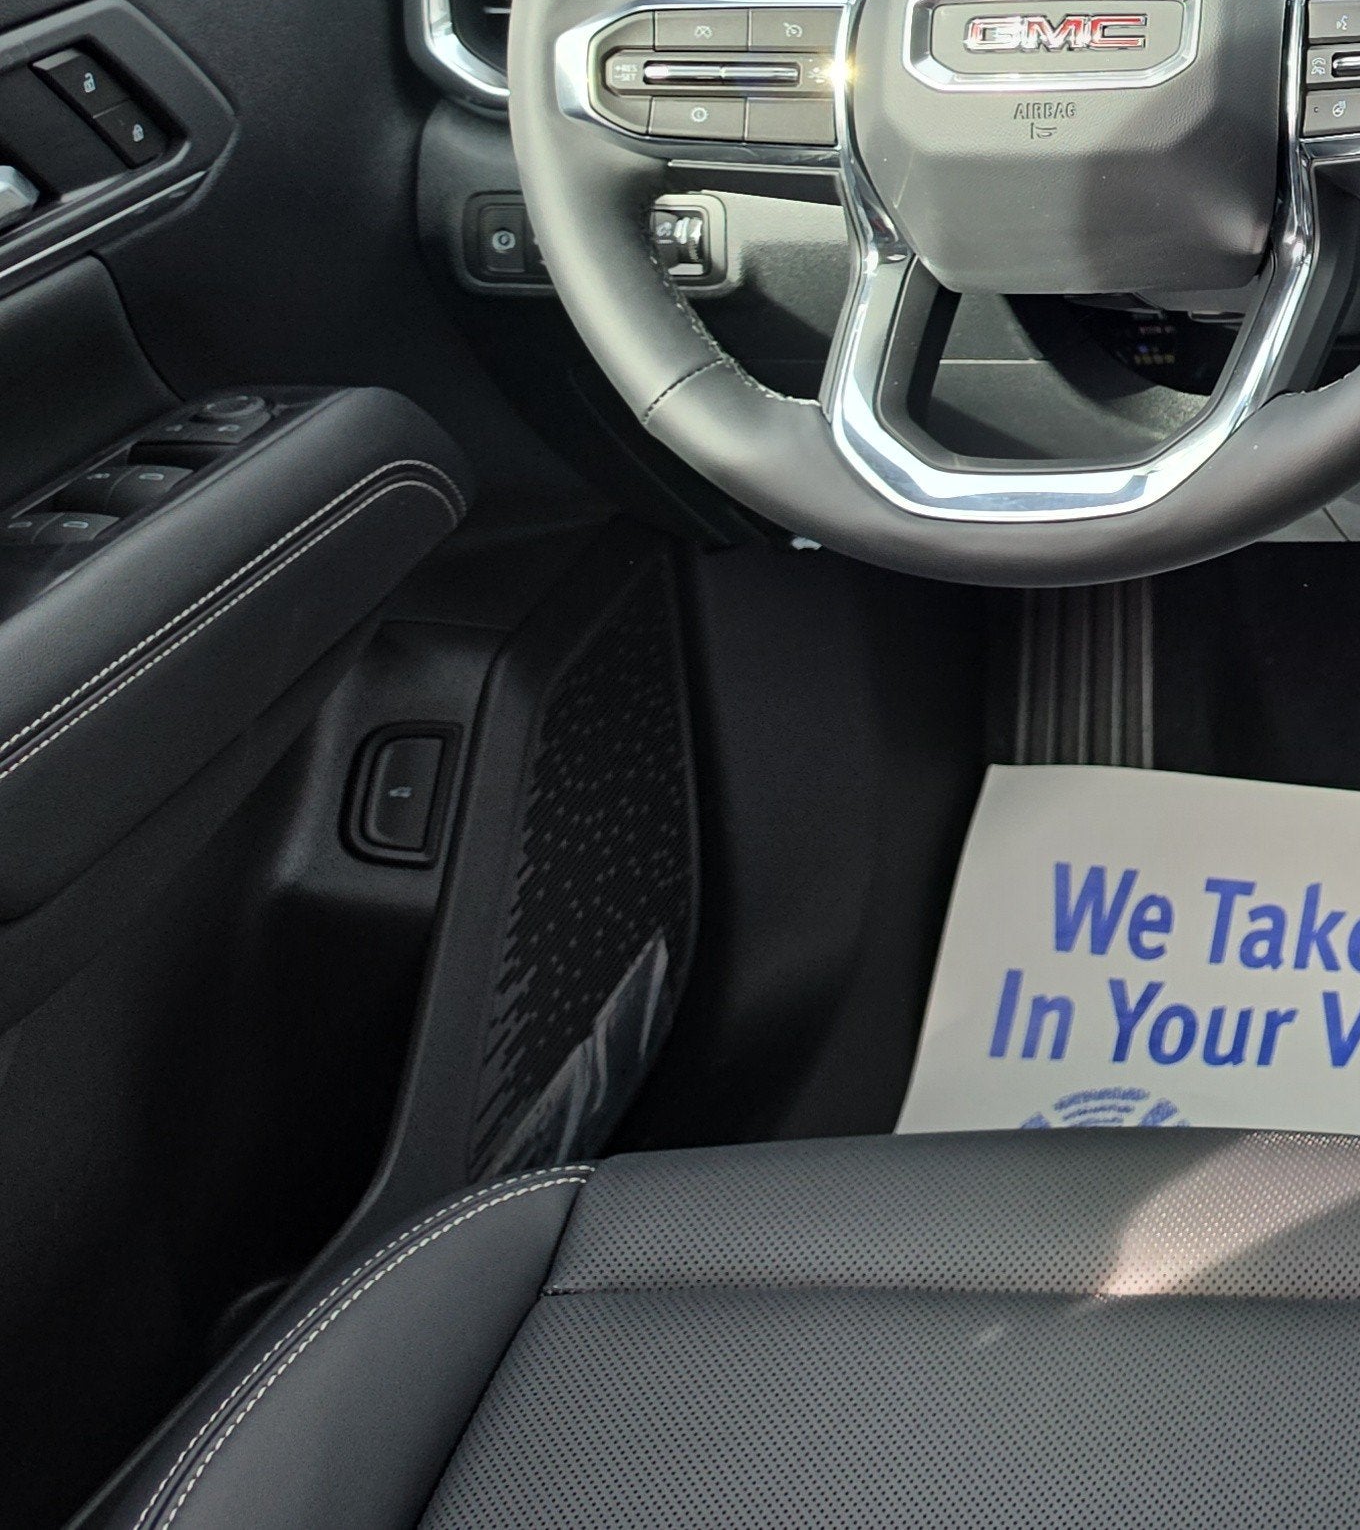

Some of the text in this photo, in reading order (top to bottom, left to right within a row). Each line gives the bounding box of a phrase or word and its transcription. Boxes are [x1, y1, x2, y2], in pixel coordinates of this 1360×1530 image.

[963, 13, 1148, 52] GMC
[1013, 101, 1078, 120] AIRBAG
[1054, 863, 1173, 961] We
[990, 971, 1073, 1060] In
[1110, 980, 1297, 1068] Your
